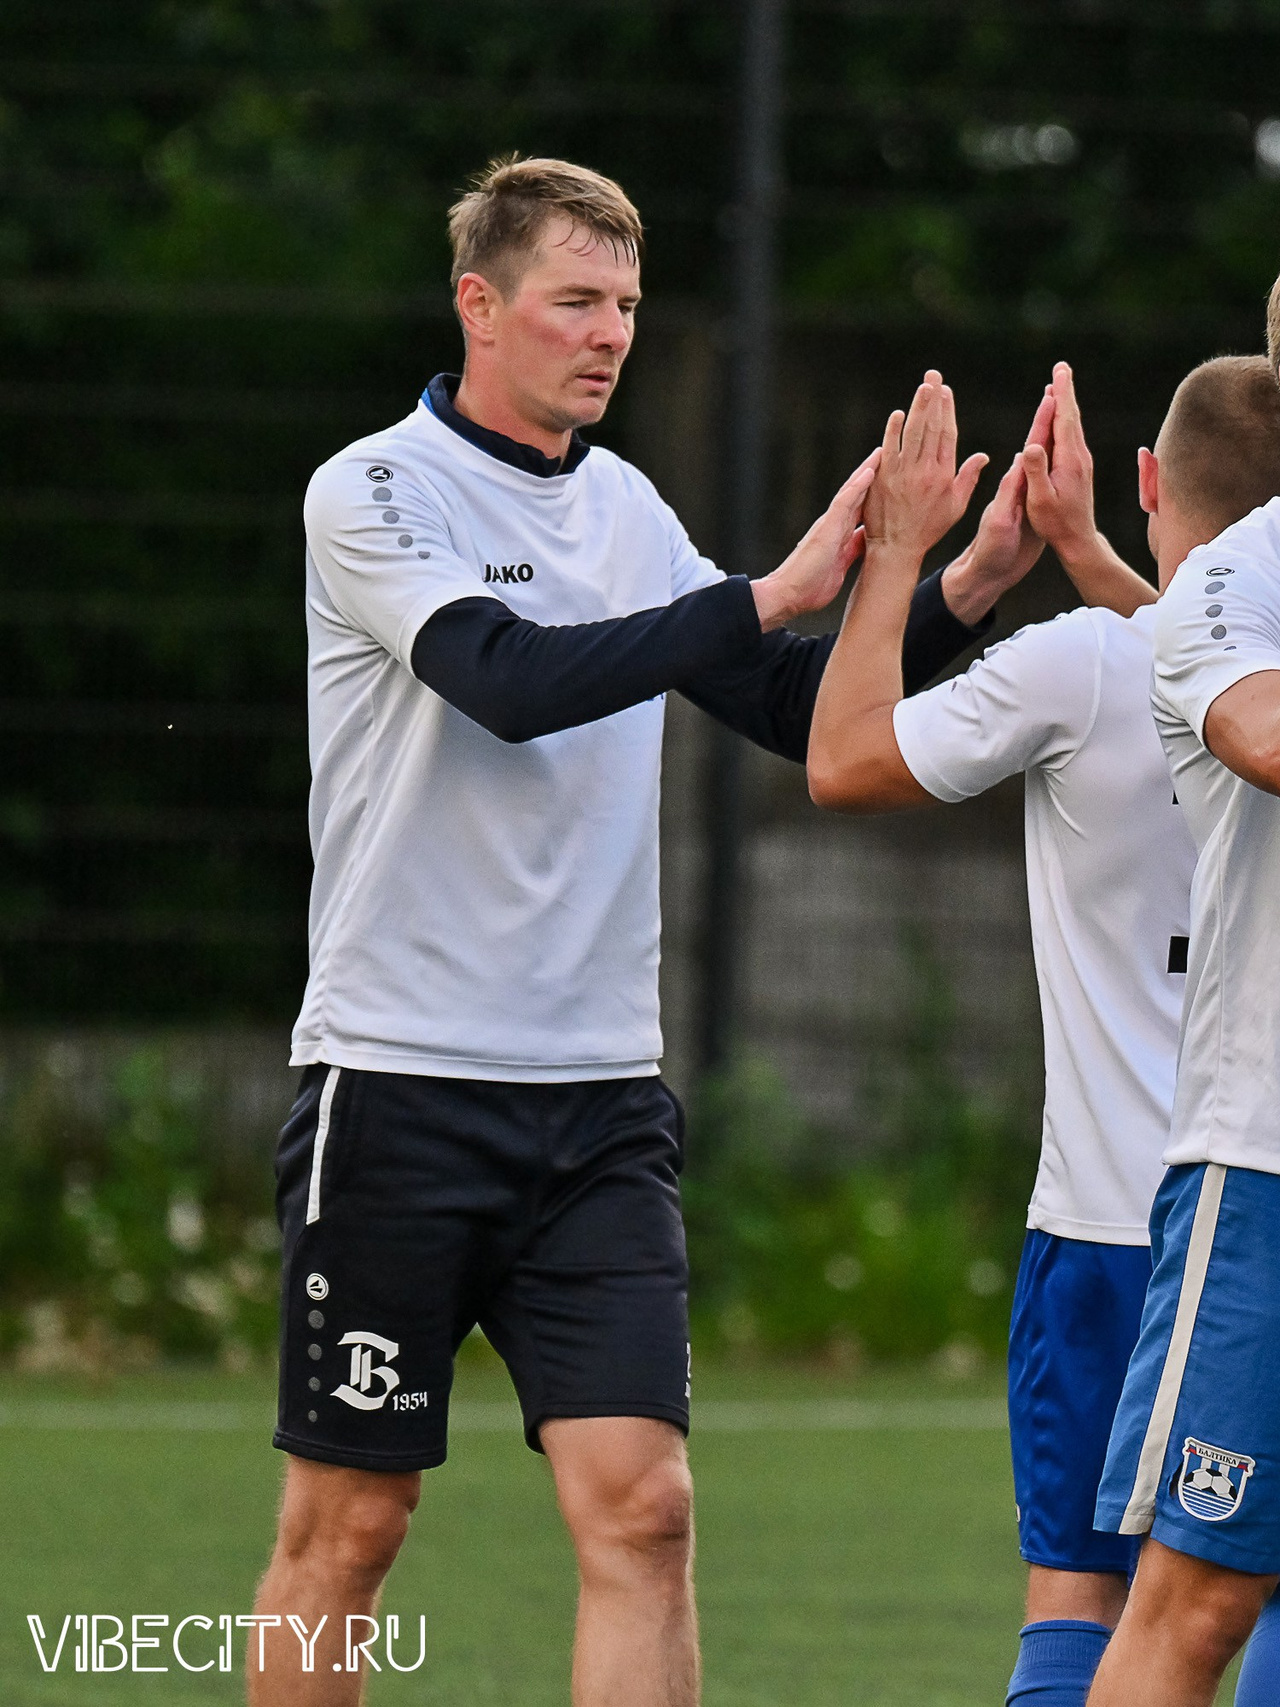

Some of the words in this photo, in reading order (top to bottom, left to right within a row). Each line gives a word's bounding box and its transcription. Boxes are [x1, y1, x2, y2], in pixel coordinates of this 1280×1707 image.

[482, 563, 534, 584] JAKO
[392, 1391, 428, 1411] 1954
[1198, 1447, 1237, 1466] БАЛТИКА
